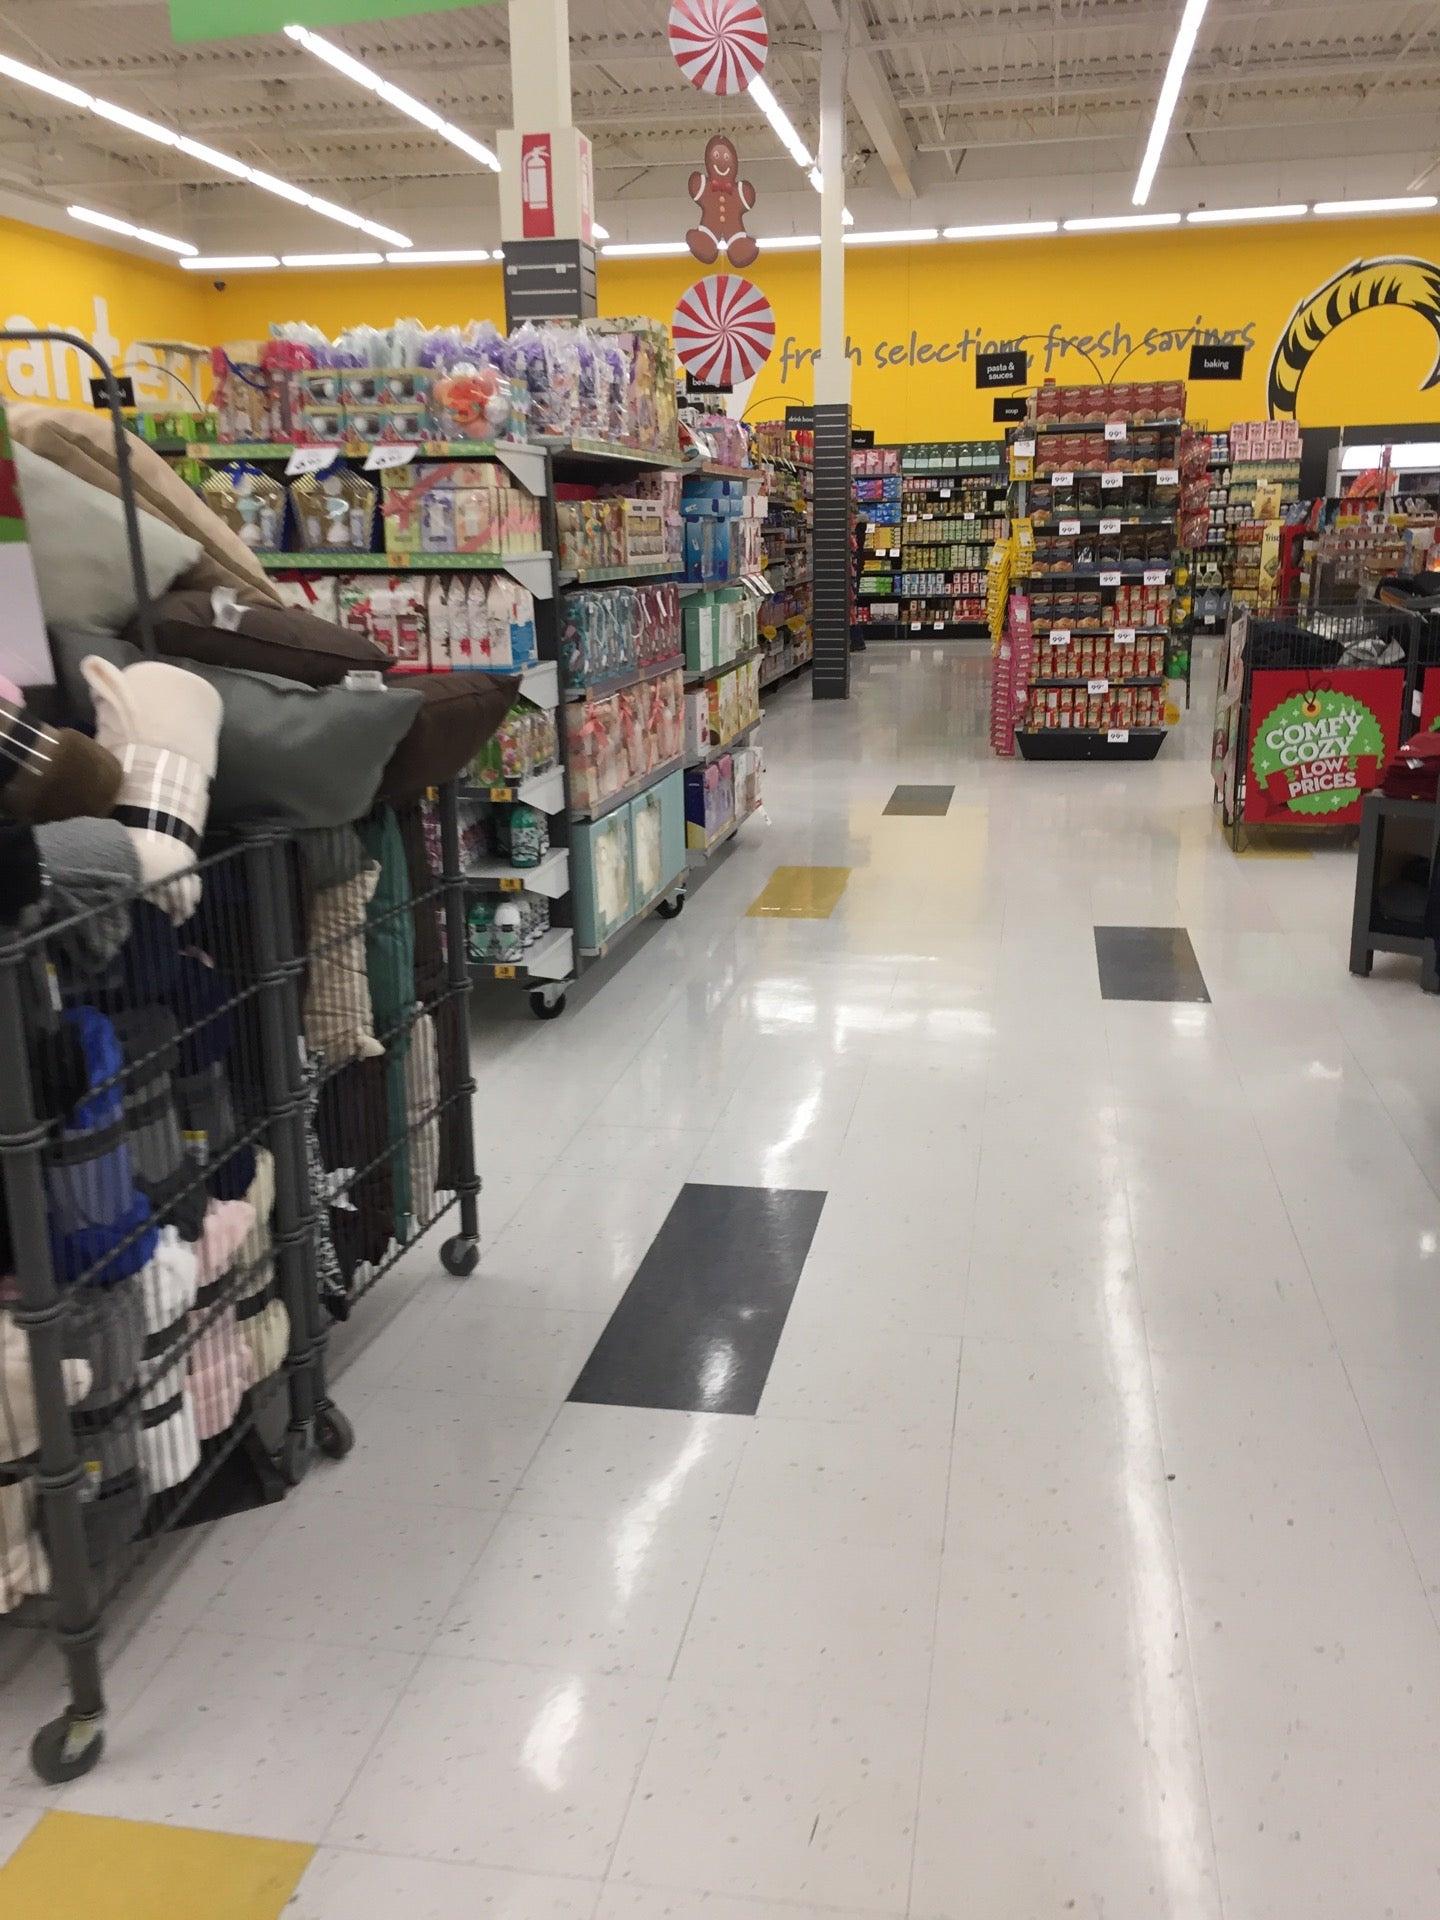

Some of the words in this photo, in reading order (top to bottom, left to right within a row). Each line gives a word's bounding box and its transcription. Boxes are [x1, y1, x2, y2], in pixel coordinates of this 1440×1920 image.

[779, 335, 862, 384] freh
[1043, 321, 1131, 373] fresh
[987, 364, 1007, 374] pasta
[1008, 361, 1015, 371] &
[988, 372, 1014, 380] sauces
[1204, 359, 1229, 370] baking
[1266, 715, 1363, 749] COMFY
[1280, 736, 1354, 766] COZY
[1300, 757, 1344, 778] LOW
[1288, 771, 1357, 797] PRICES
